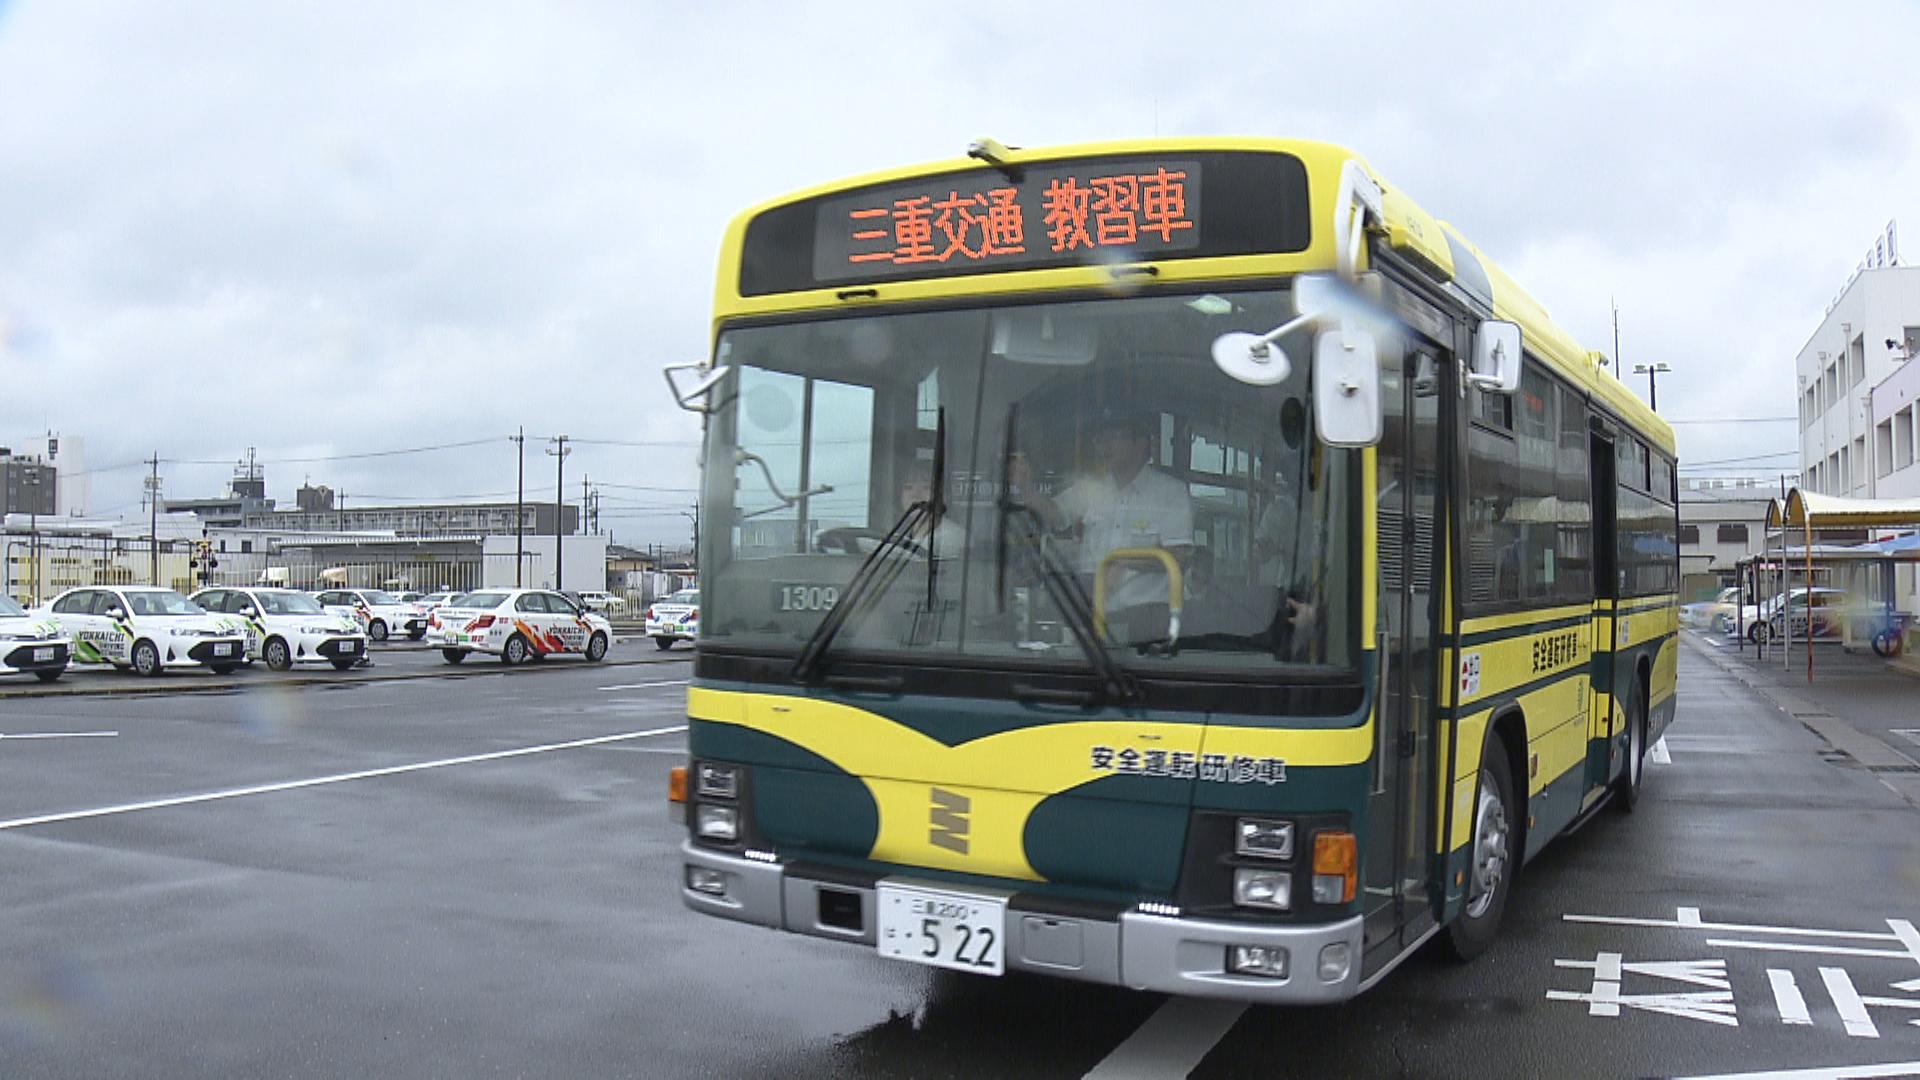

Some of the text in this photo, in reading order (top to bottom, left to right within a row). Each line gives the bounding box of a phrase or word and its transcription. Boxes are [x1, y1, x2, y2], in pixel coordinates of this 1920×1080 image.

[848, 167, 1193, 263] 三重交通 教習車
[781, 586, 839, 610] 1309
[79, 630, 125, 643] YOKKAICHI
[1091, 747, 1287, 786] 安全運転研修車
